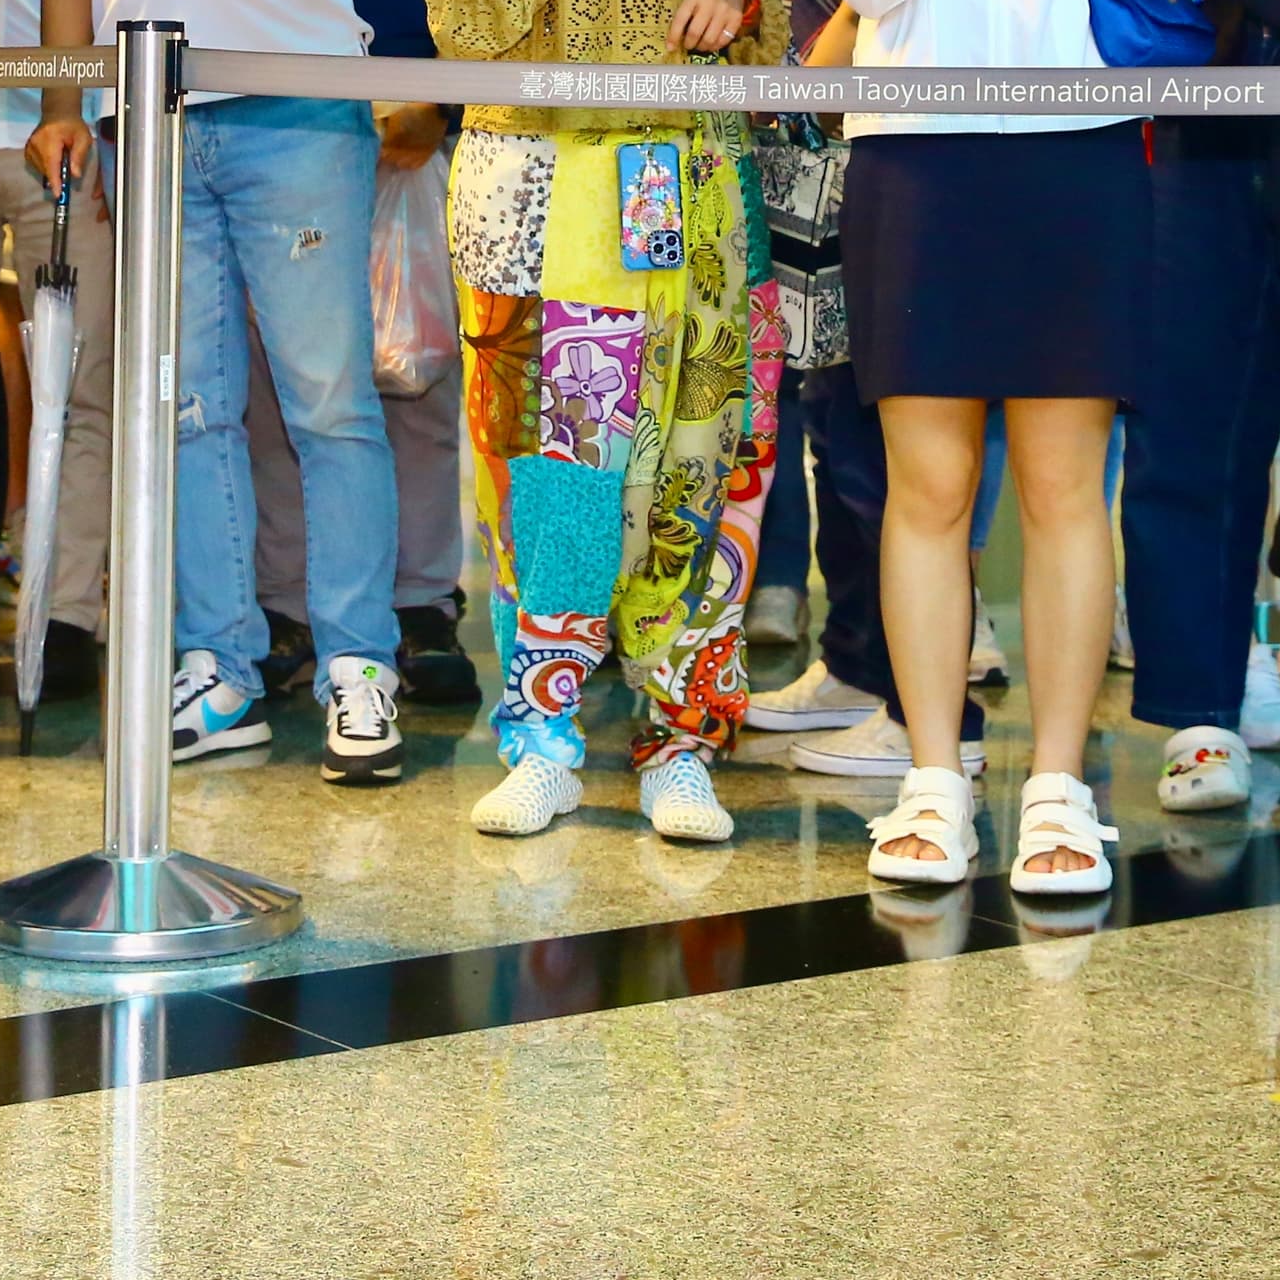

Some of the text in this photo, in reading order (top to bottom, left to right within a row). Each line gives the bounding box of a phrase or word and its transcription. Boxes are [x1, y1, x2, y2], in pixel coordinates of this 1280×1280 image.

[58, 56, 105, 84] Airport
[519, 70, 1265, 110] 臺灣桃園國際機場 Taiwan Taoyuan International Airport
